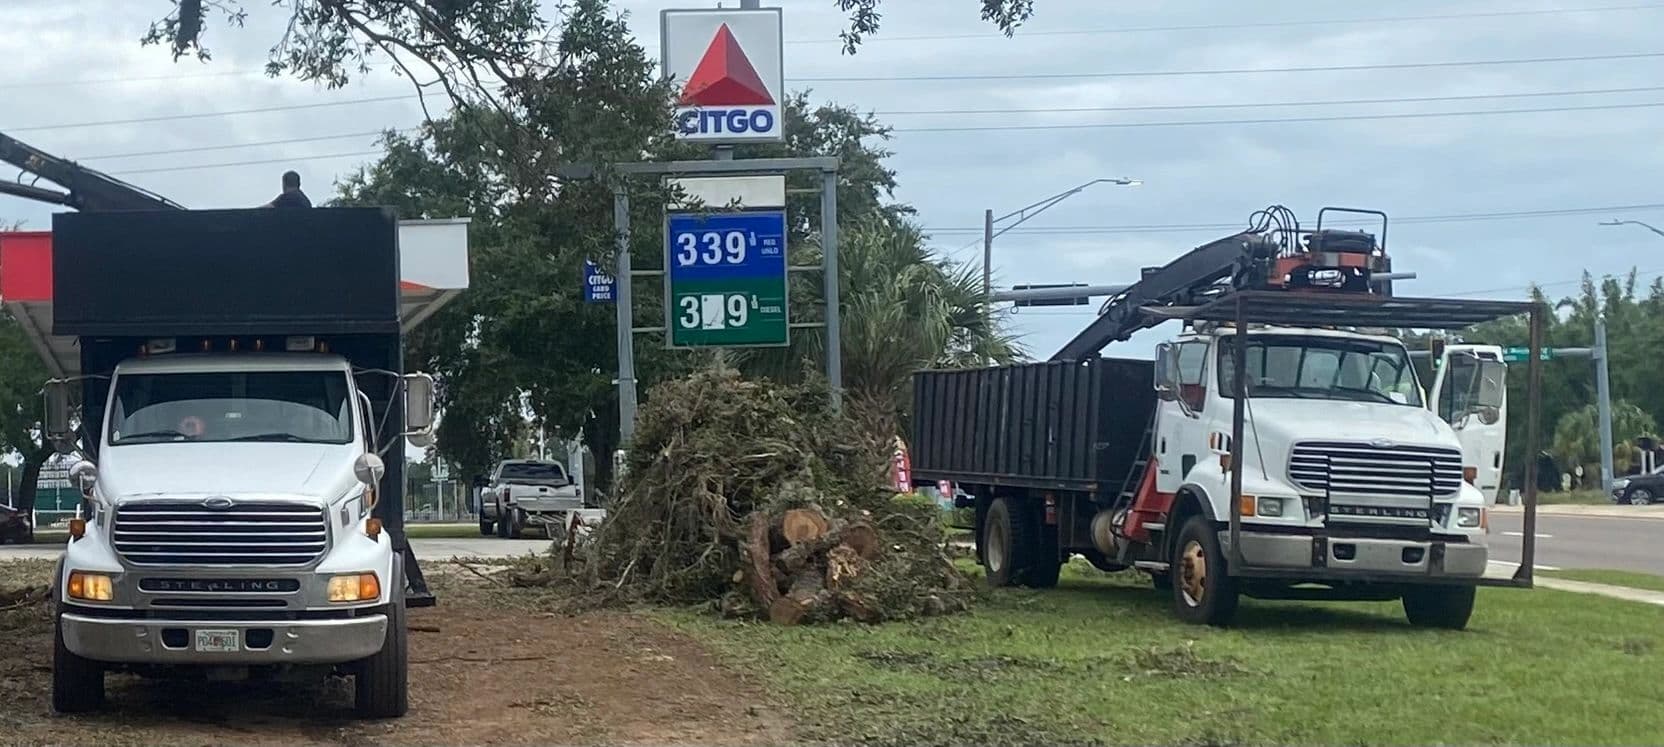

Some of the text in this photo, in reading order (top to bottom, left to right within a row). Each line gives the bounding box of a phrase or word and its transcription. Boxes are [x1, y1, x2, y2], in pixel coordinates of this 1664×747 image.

[680, 109, 773, 133] CITGO
[677, 231, 746, 266] 339
[588, 274, 614, 285] CITGO
[680, 294, 748, 329] 39
[760, 305, 781, 313] DIESEL
[1331, 506, 1427, 517] STERLING
[160, 581, 278, 590] STERLING
